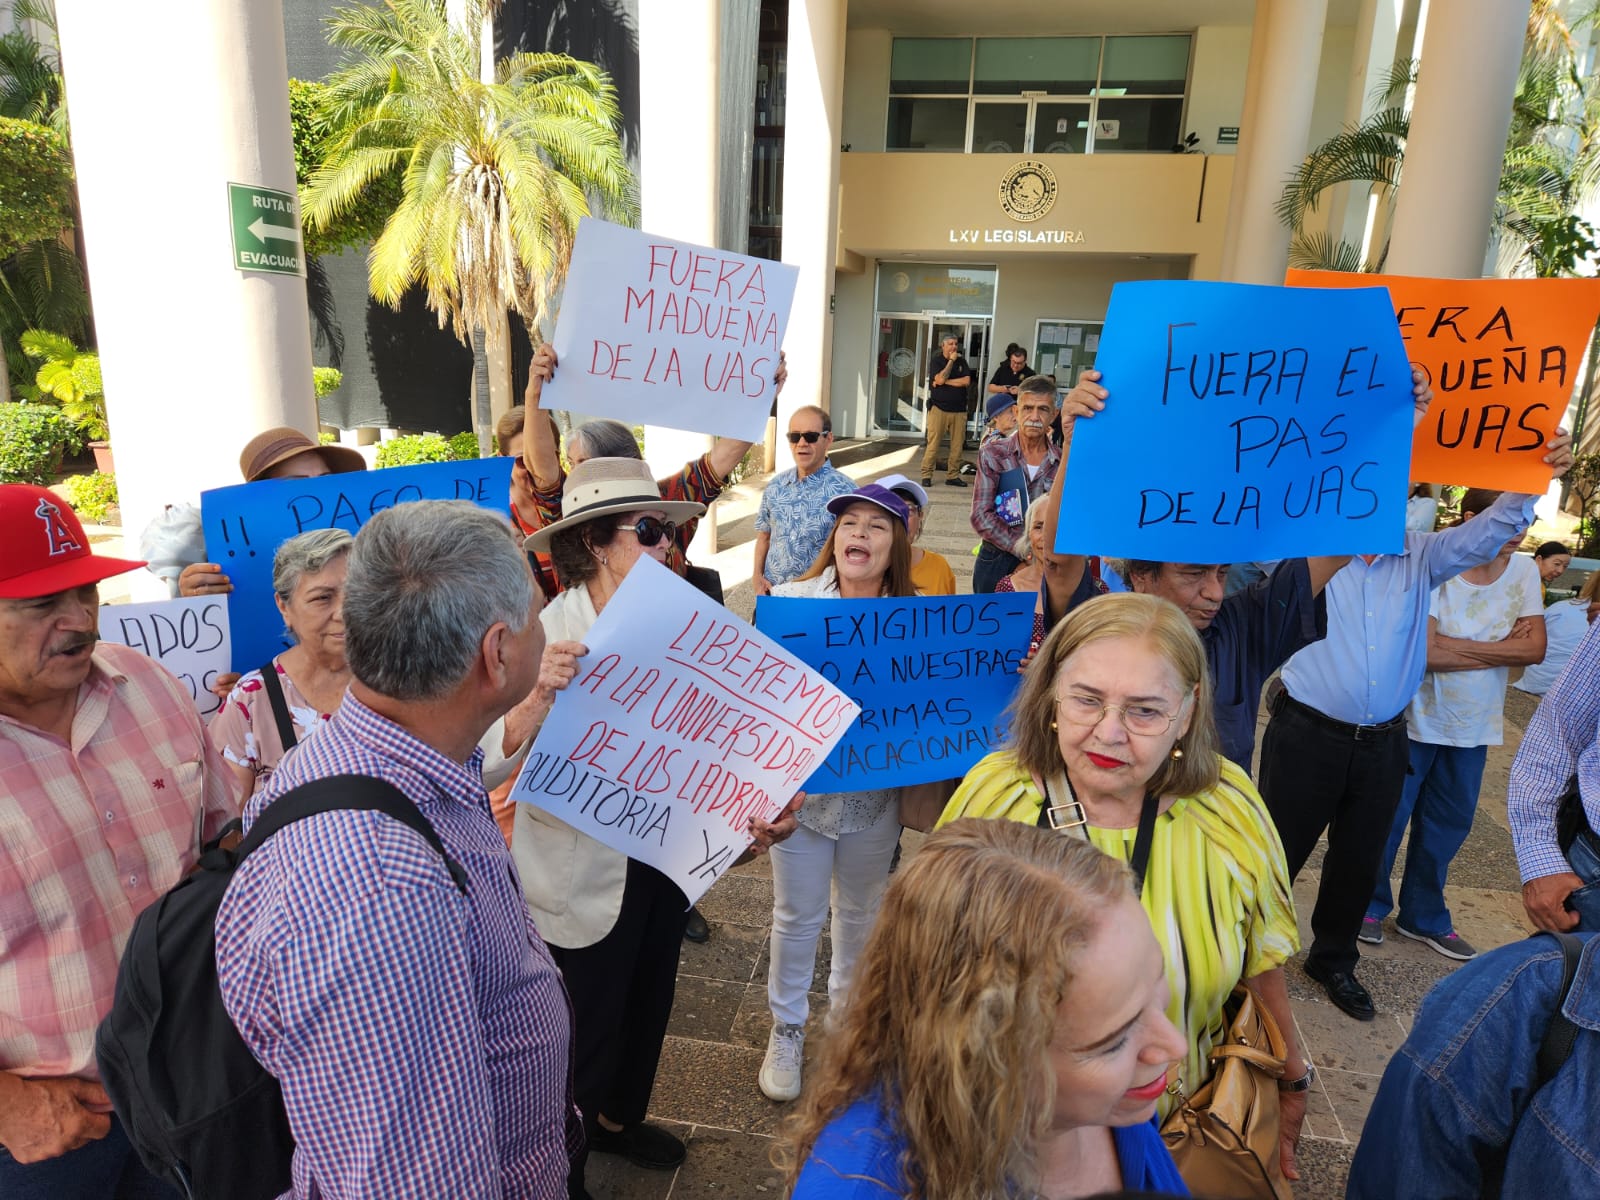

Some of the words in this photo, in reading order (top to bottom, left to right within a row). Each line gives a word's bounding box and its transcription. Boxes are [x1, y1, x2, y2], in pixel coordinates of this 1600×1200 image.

[252, 195, 285, 212] RUTA
[240, 251, 299, 268] EVACUACI
[950, 229, 979, 243] LXV
[984, 229, 1085, 243] LEGISLATURA
[648, 244, 767, 304] FUERA
[587, 340, 633, 380] DE
[643, 347, 682, 387] LA
[704, 351, 771, 398] UAS
[1162, 322, 1309, 405] FUERA
[1336, 346, 1386, 397] EL
[1229, 413, 1348, 473] PAS
[1436, 403, 1550, 453] UAS
[453, 477, 491, 501] DE
[1138, 489, 1198, 528] DE
[1212, 486, 1260, 530] LA
[1283, 461, 1379, 519] UAS
[579, 654, 621, 694] A
[609, 665, 661, 714] LA
[669, 610, 853, 739] LIBEREMOS
[852, 658, 876, 685] A
[891, 648, 1023, 684] NUESTRAS
[846, 697, 971, 733] RIMAS
[569, 721, 628, 773] DE
[617, 740, 681, 793] LOS
[522, 752, 671, 847] AUDITORIA
[688, 829, 739, 880] YA
